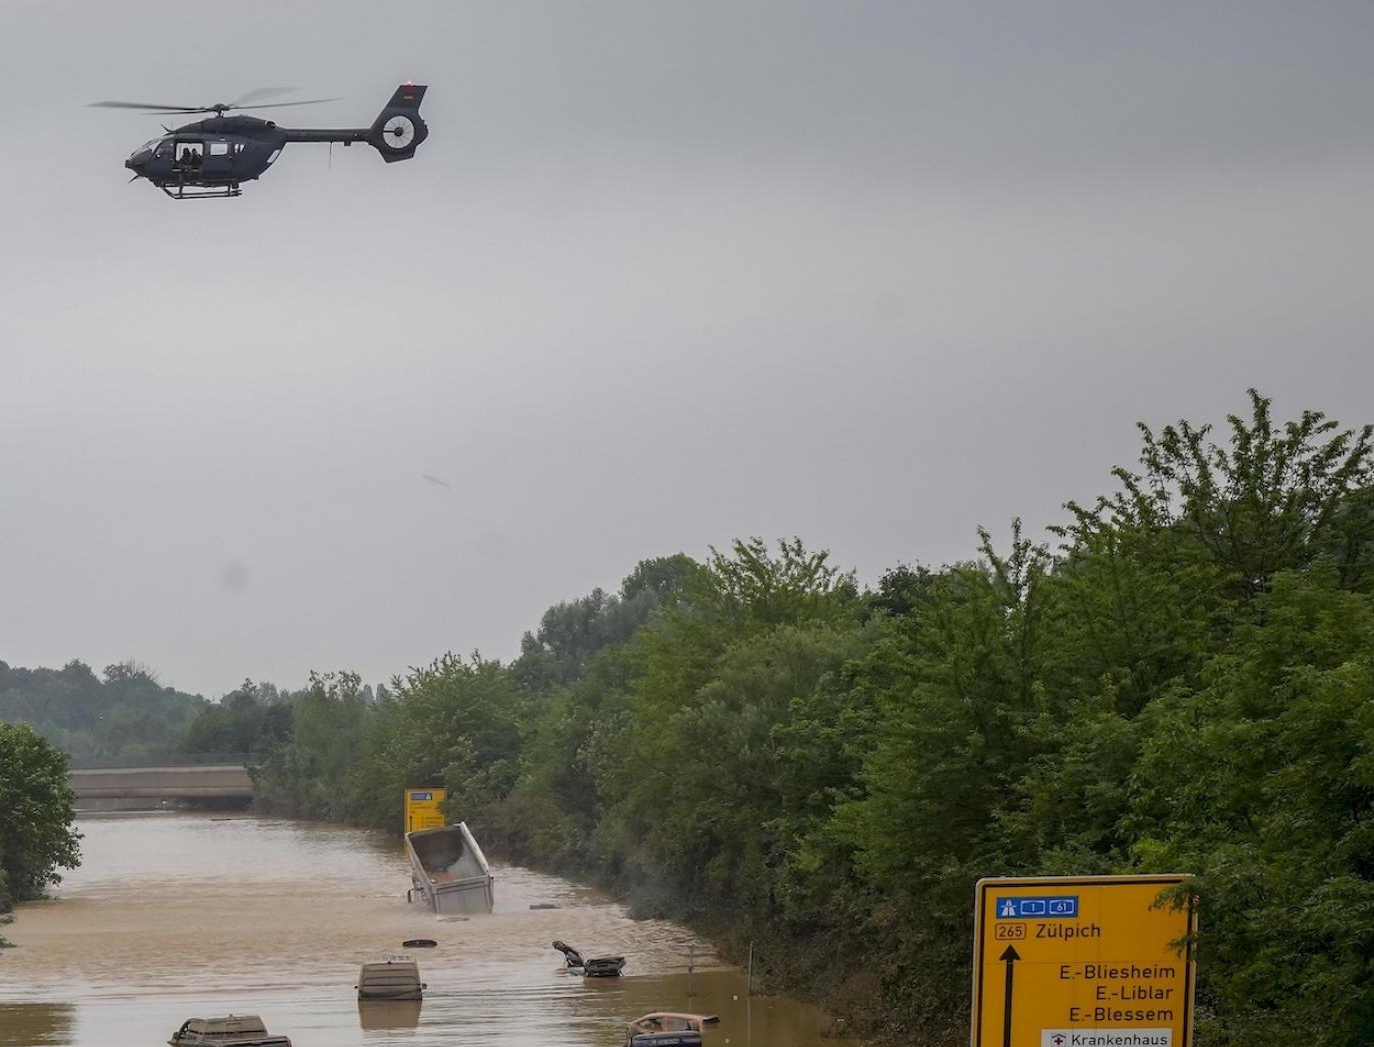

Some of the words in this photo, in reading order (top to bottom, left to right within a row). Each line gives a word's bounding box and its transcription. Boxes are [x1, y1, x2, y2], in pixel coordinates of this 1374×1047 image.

[1056, 902, 1067, 912] 61
[999, 925, 1022, 938] 265
[1035, 923, 1101, 941] Zülpich
[1059, 964, 1175, 980] E.-Bliesheim
[1096, 985, 1174, 1000] E.-Liblar
[1069, 1007, 1174, 1022] E.-Blessem
[1071, 1034, 1168, 1046] Krankenhaus
